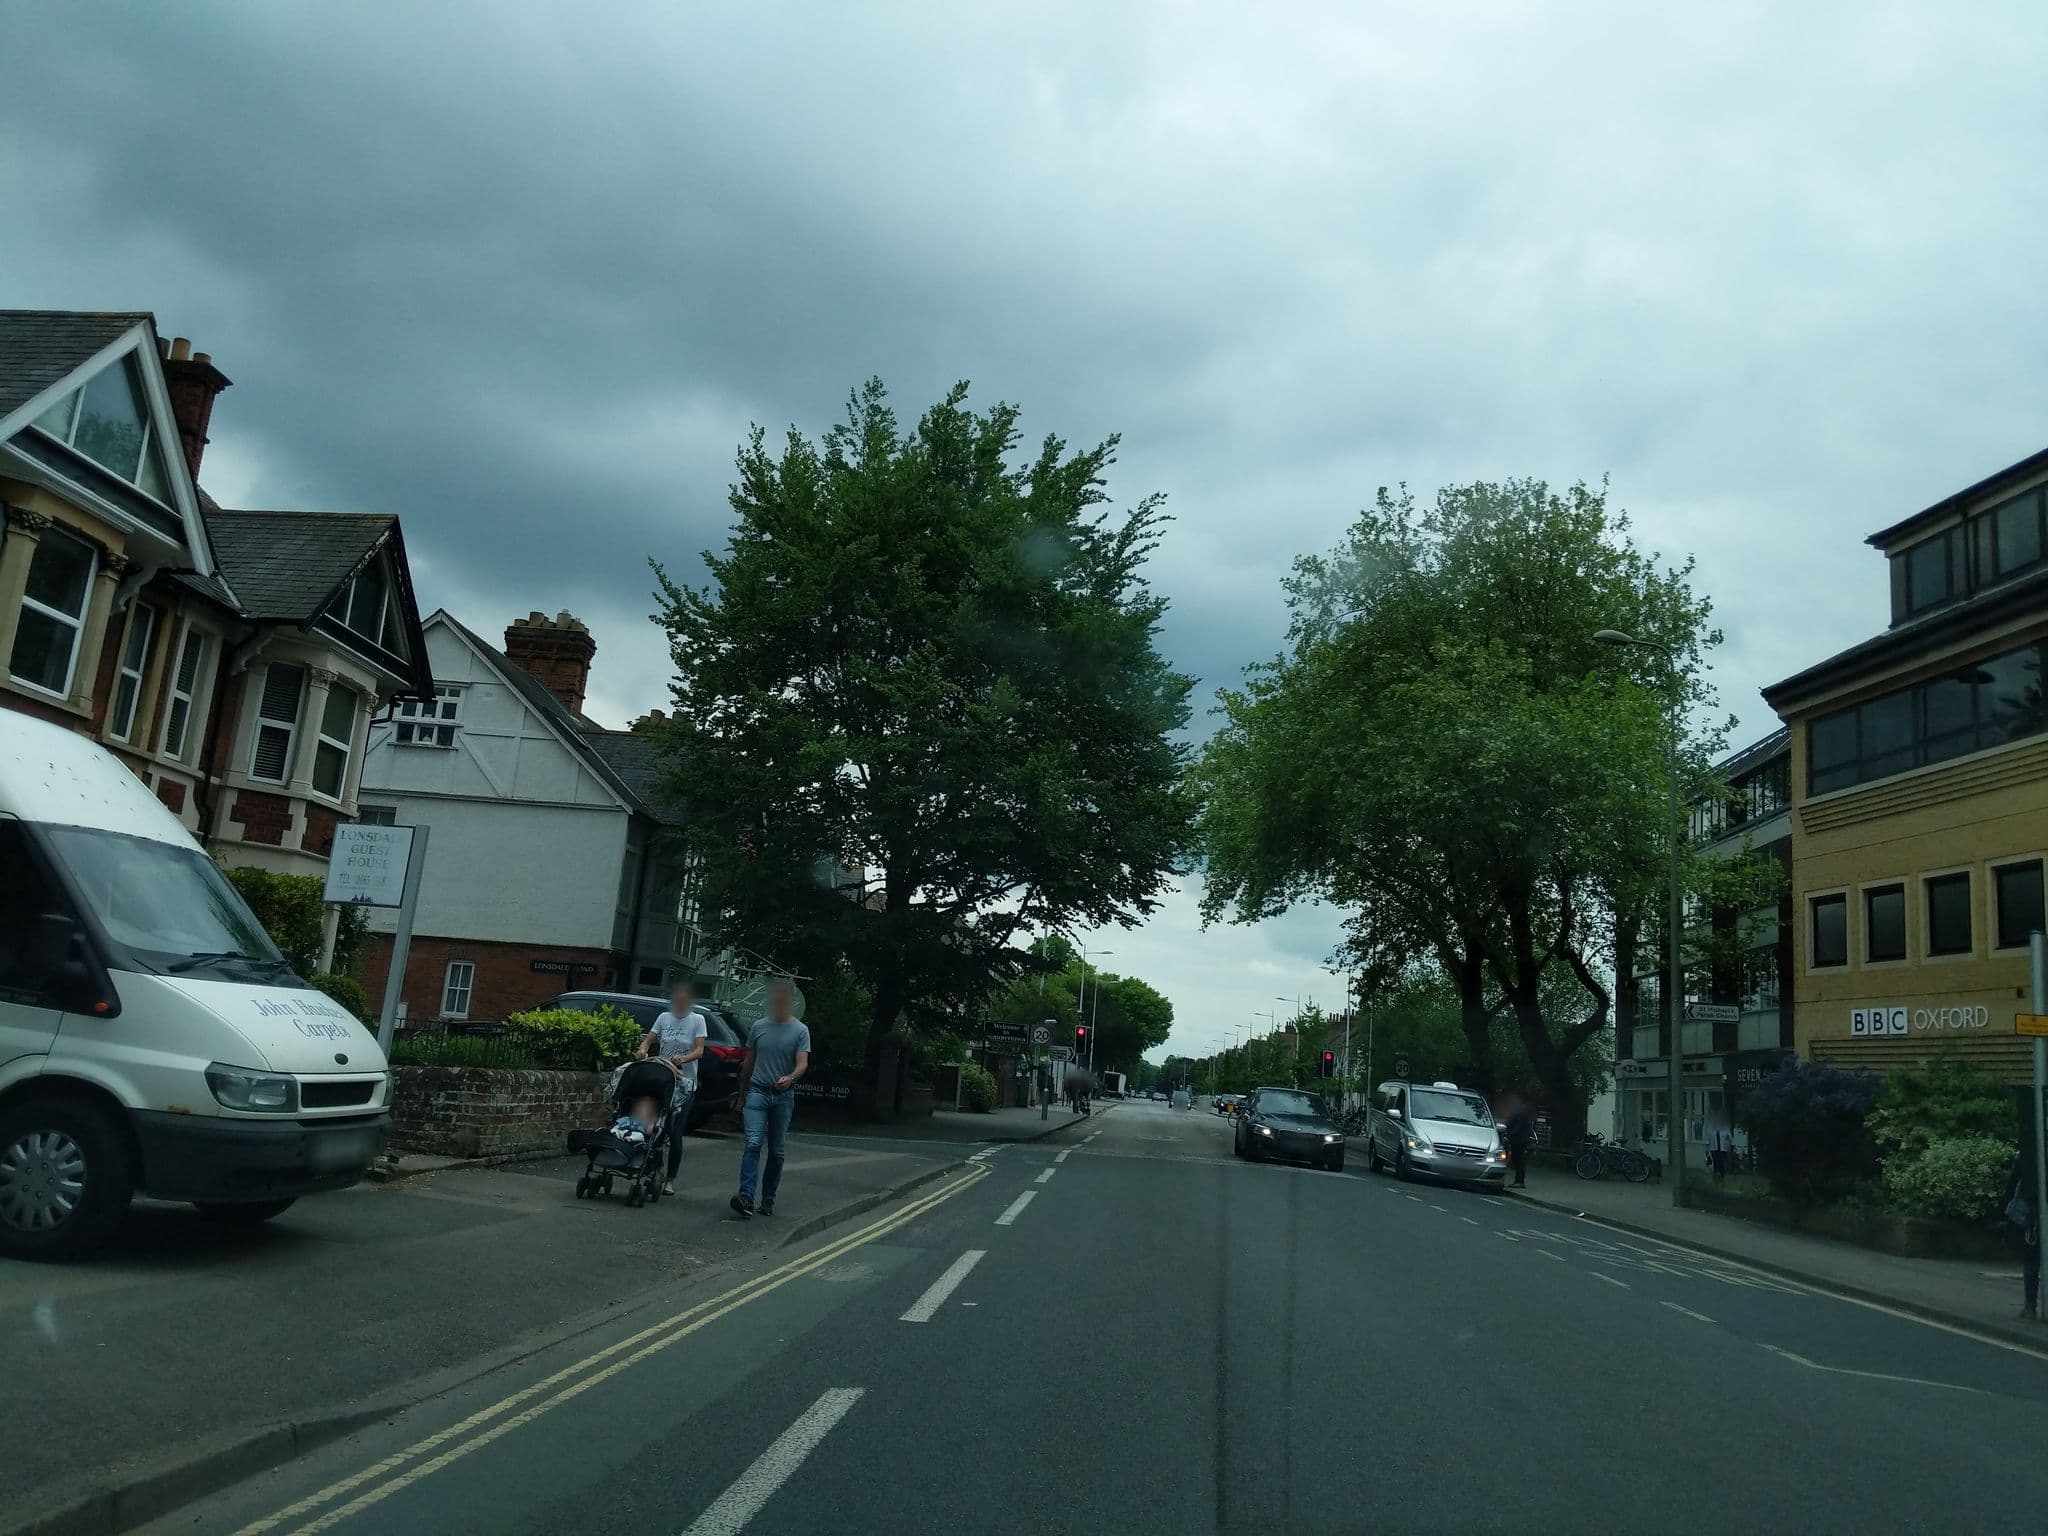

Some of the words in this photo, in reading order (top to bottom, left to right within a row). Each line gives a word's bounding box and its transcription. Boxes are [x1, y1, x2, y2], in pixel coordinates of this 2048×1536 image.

[340, 830, 399, 844] LONSDAL
[351, 844, 391, 856] GUEST
[346, 857, 390, 869] HOUSE
[534, 962, 569, 971] LONSDALE
[250, 999, 297, 1016] John
[1854, 1010, 1905, 1032] BBC
[1914, 1006, 1989, 1030] OXFORD
[293, 1019, 351, 1040] Carpets
[1035, 1031, 1049, 1040] 20
[1398, 1063, 1409, 1073] 20
[794, 1083, 824, 1092] ONSDALE
[831, 1086, 850, 1095] ROAD
